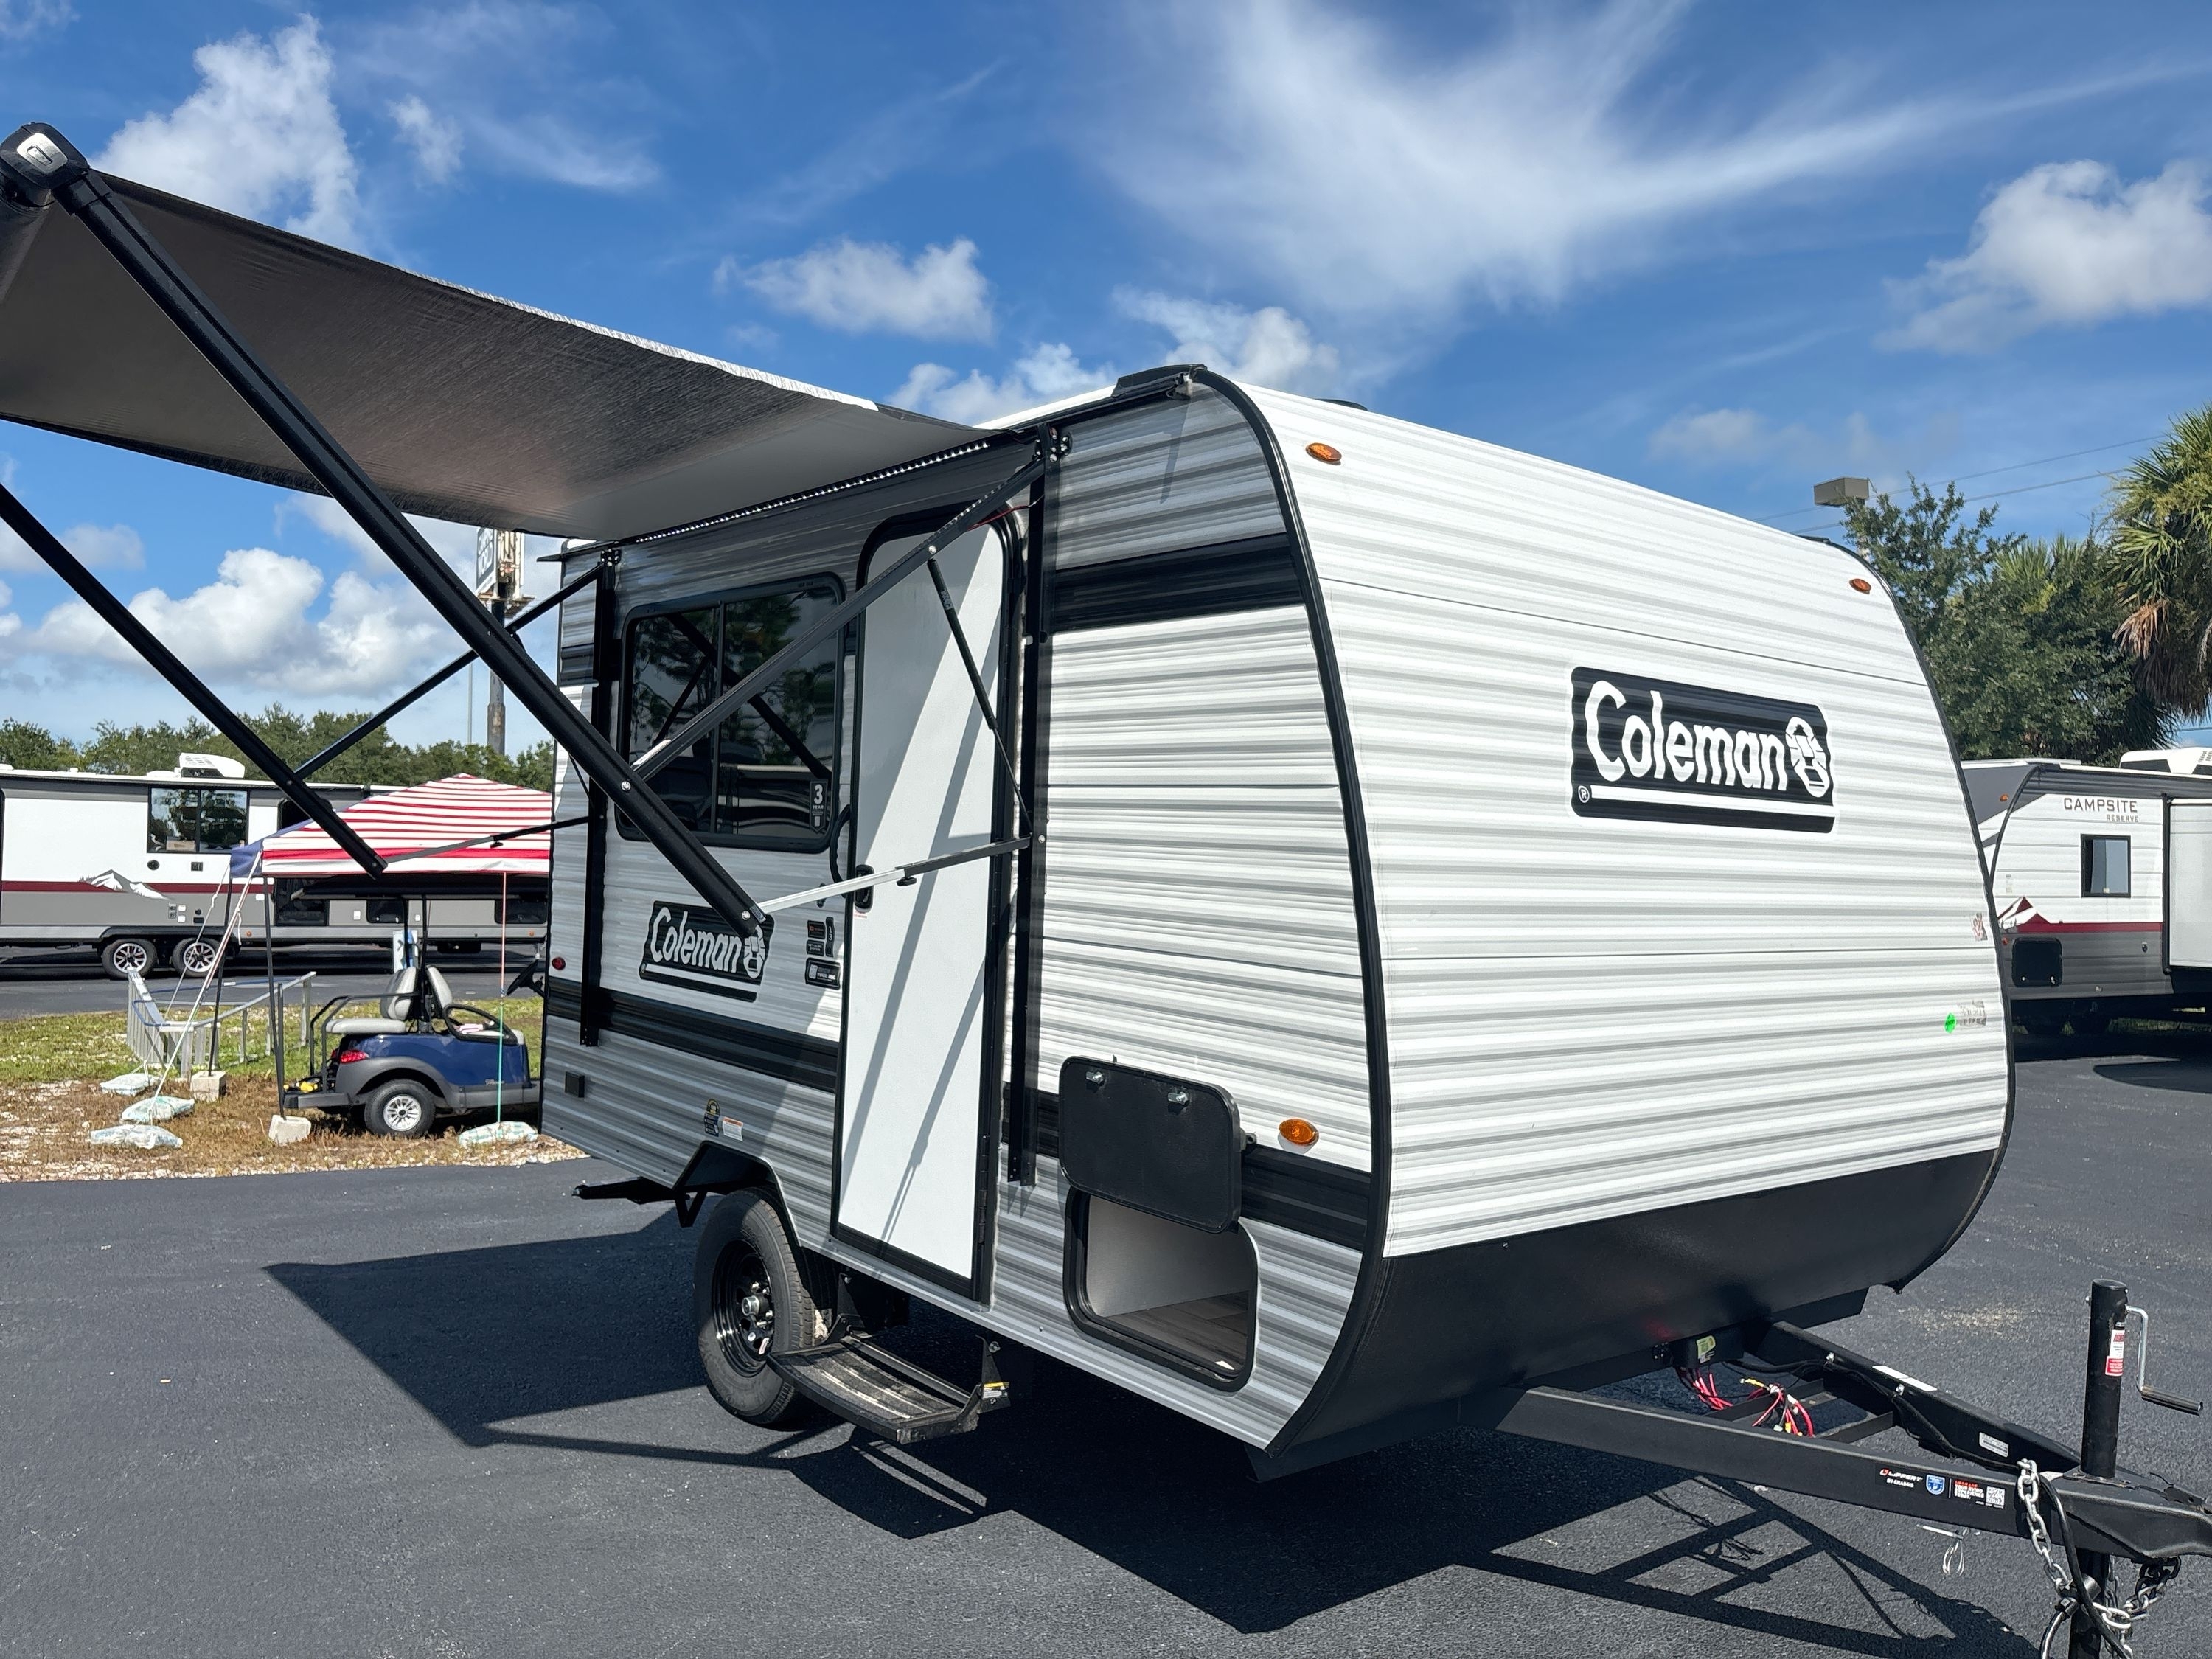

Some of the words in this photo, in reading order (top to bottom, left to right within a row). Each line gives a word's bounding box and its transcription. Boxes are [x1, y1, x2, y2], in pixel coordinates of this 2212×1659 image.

[1585, 680, 1789, 792] Coleman
[814, 784, 823, 804] 3
[2064, 797, 2138, 813] CAMPSITE
[2106, 814, 2139, 823] RESERVE
[650, 906, 742, 973] Coleman
